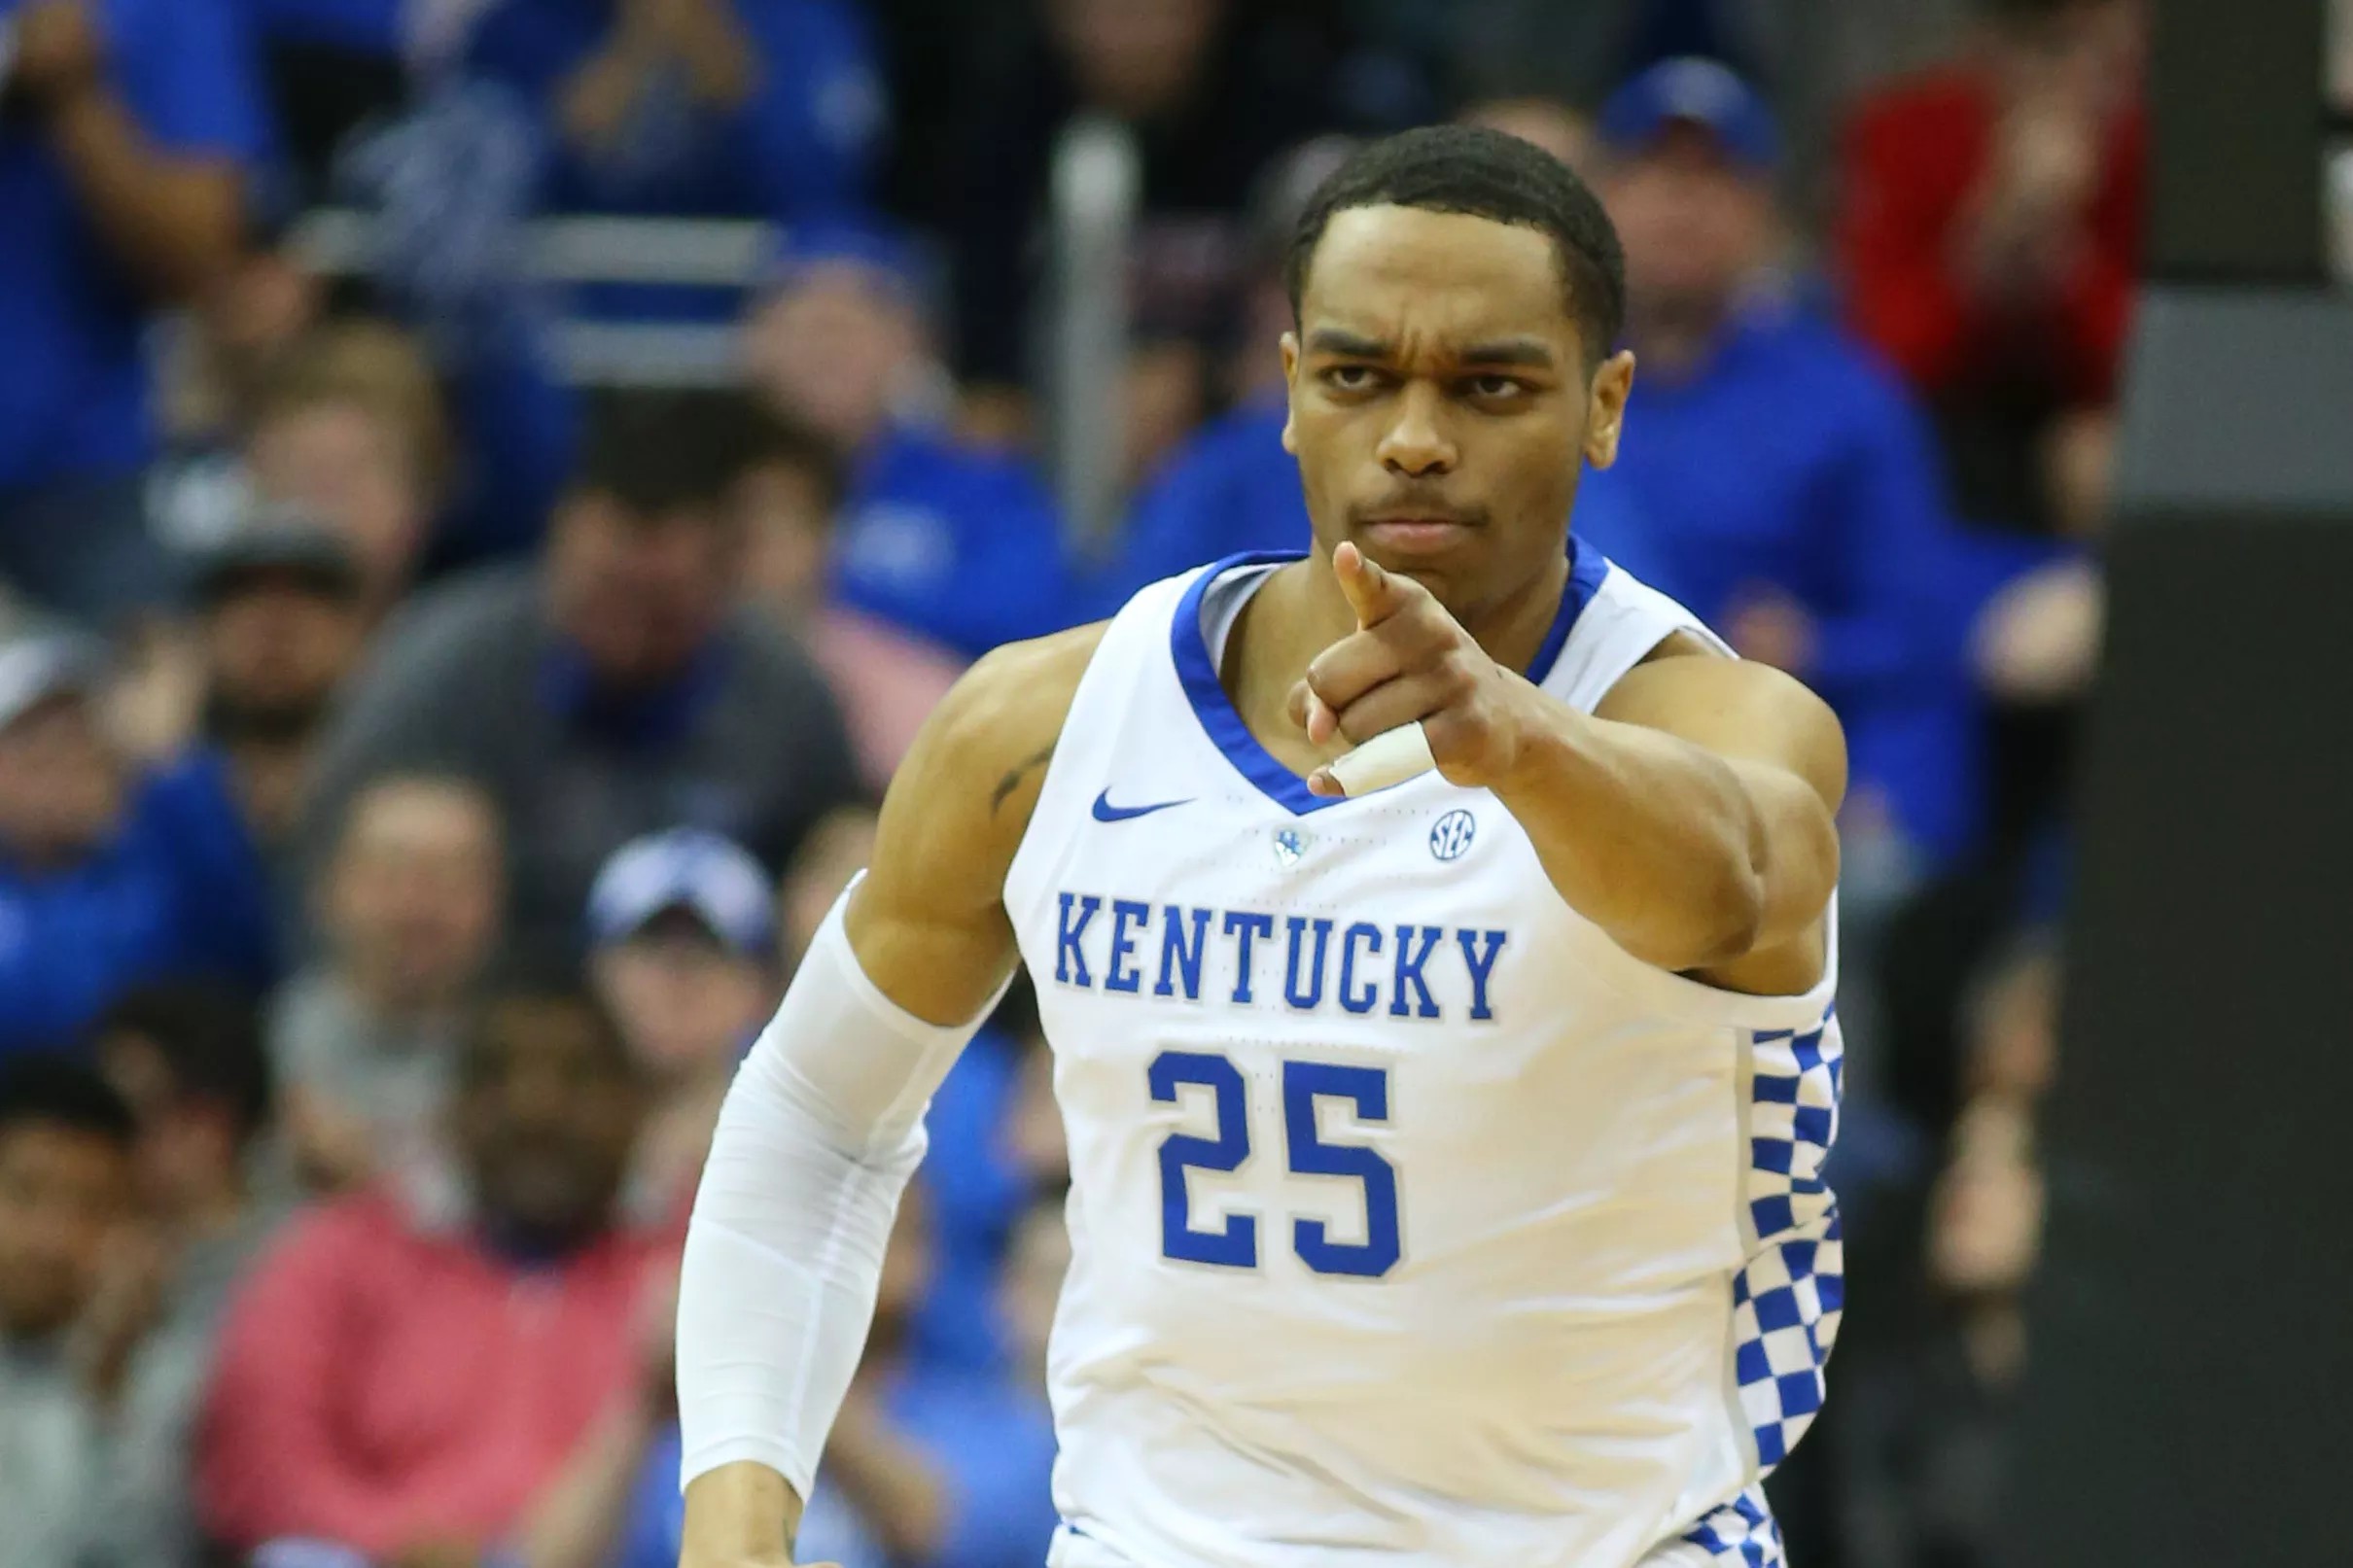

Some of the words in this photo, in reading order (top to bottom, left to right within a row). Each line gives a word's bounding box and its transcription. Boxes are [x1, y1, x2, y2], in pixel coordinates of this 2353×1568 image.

[1430, 810, 1475, 860] SEC
[1055, 891, 1506, 1020] KENTUCKY
[1148, 1051, 1400, 1277] 25
